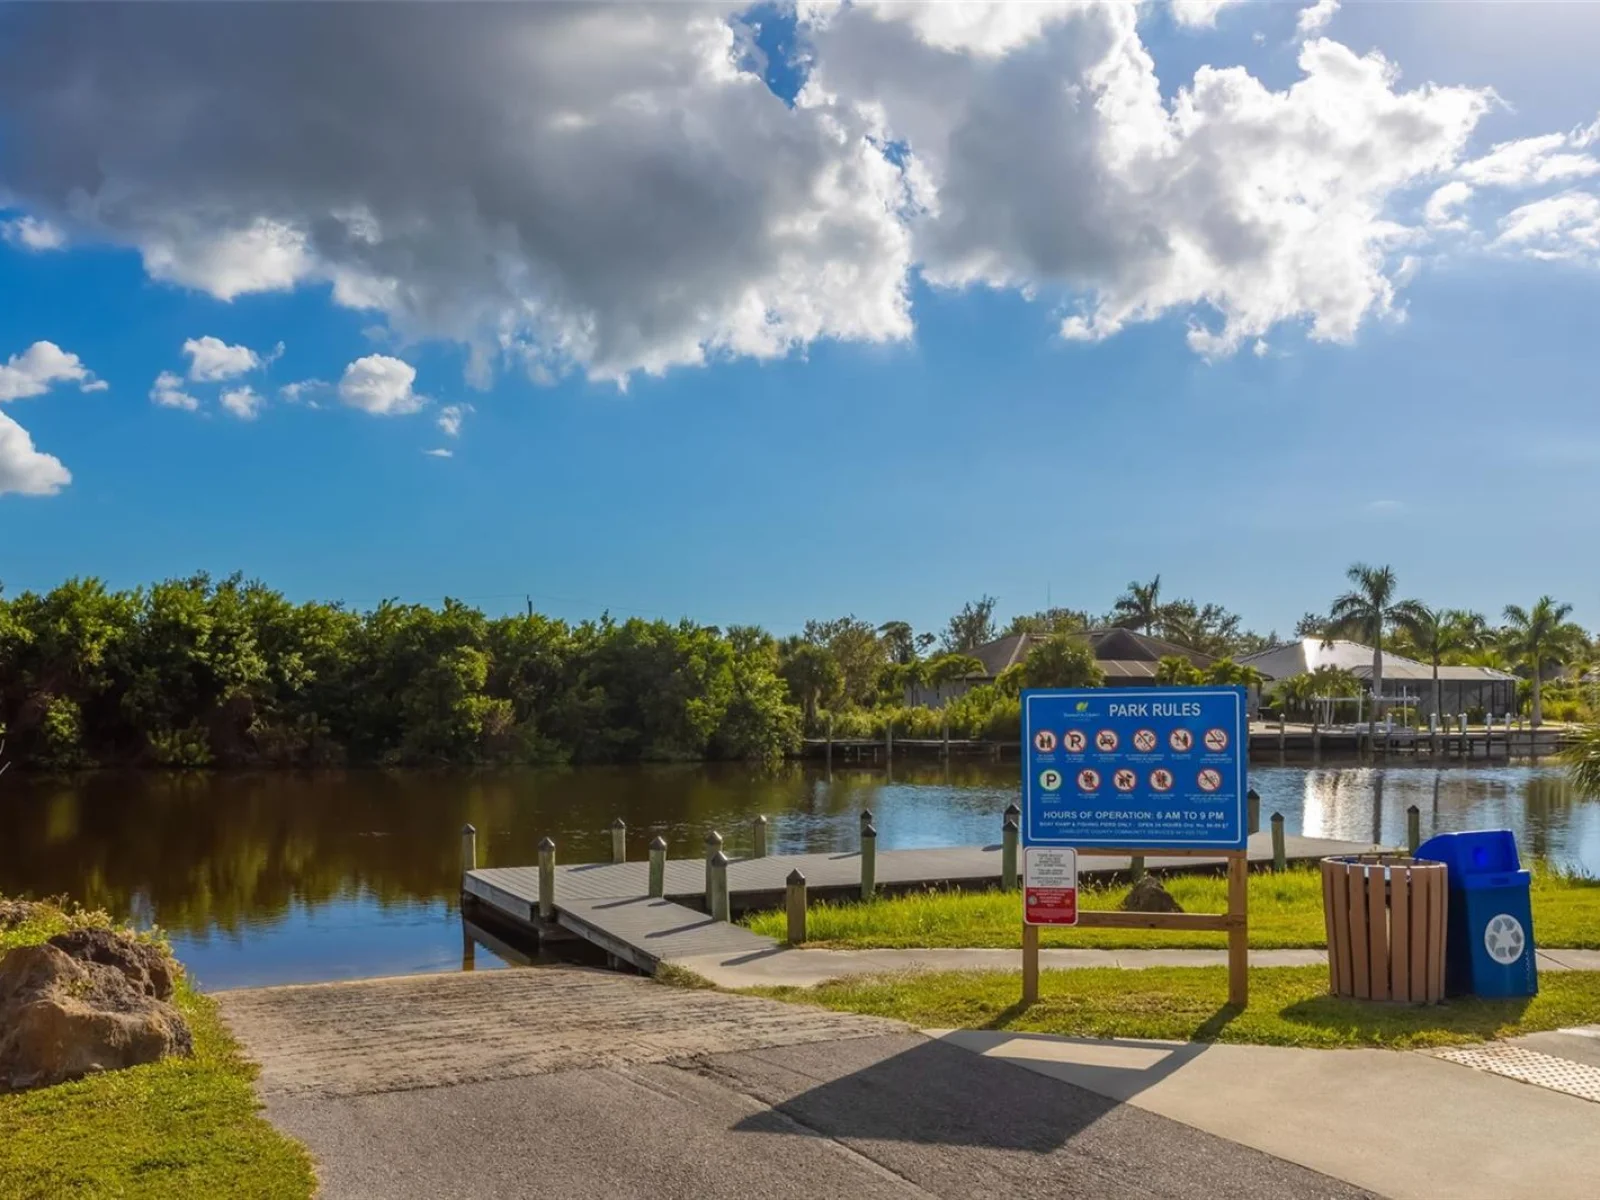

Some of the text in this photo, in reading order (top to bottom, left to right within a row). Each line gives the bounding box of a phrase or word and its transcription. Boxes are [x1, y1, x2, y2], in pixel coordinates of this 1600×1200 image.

[1109, 703, 1149, 717] PARK
[1152, 702, 1201, 717] RULES
[1046, 773, 1057, 787] P
[1043, 811, 1225, 820] HOURS OF OPERATION: 6 AM TO 9 PM
